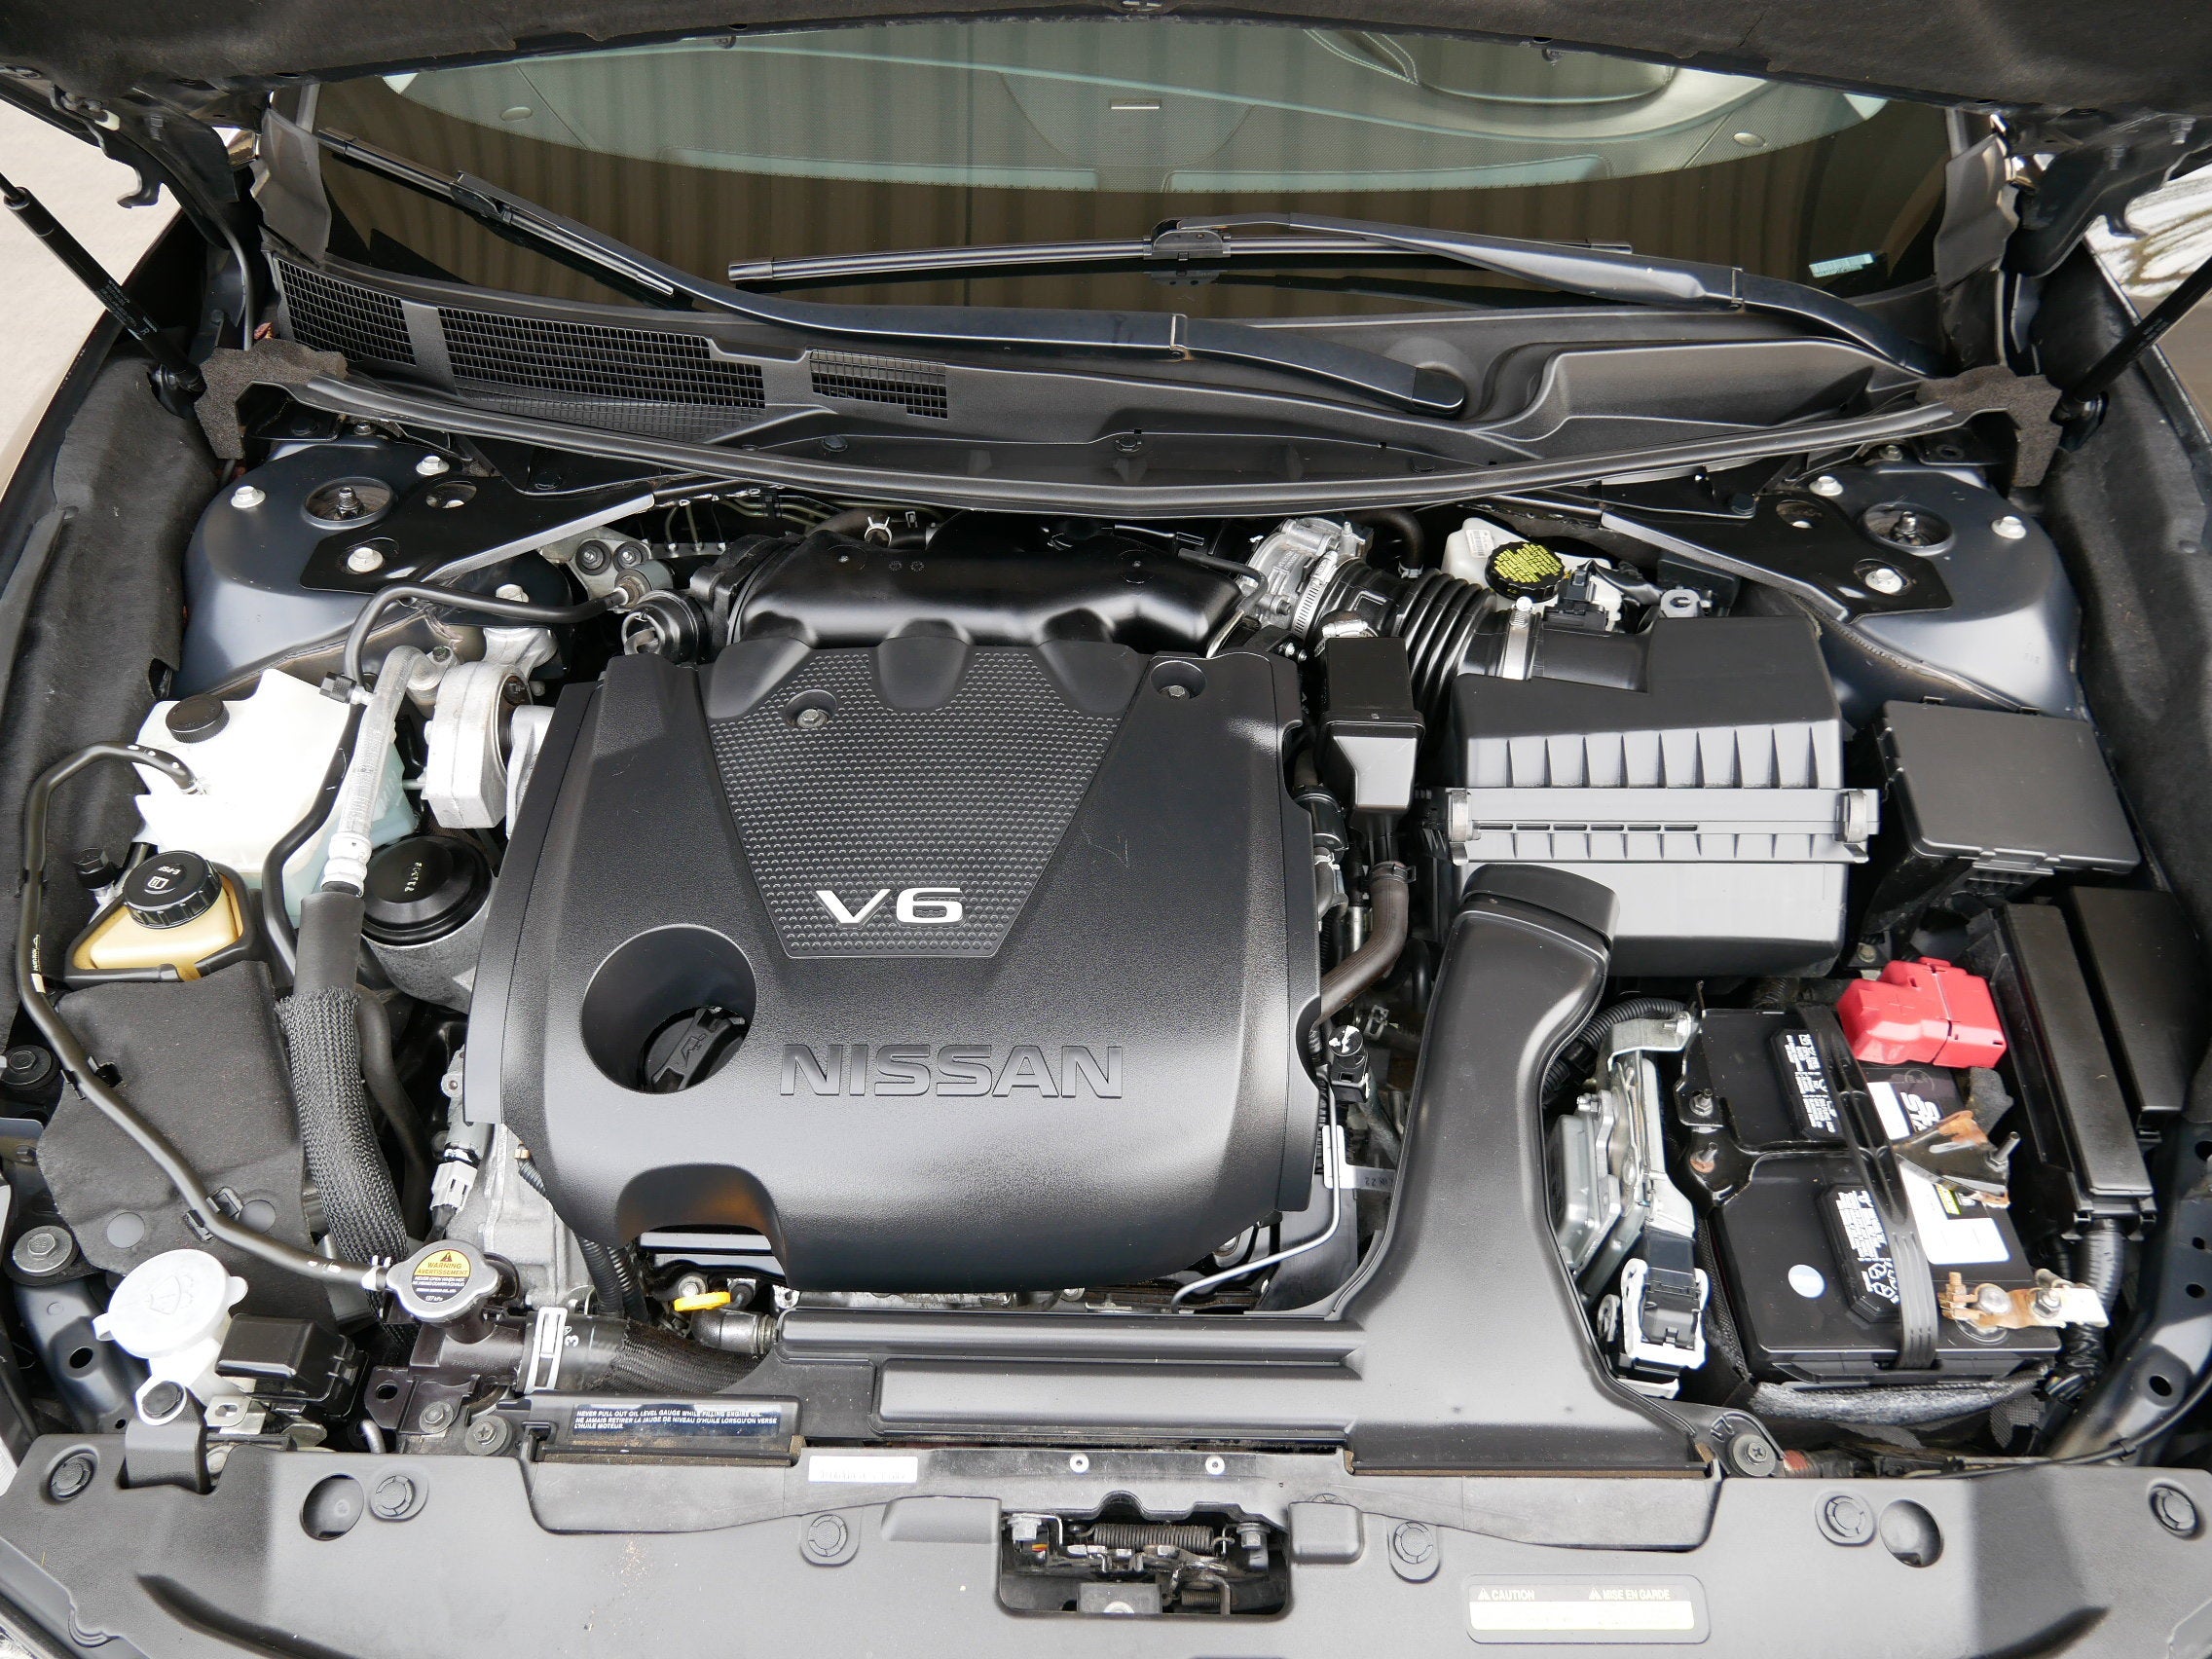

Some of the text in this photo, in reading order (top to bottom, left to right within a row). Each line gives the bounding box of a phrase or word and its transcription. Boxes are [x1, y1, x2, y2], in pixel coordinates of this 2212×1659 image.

[158, 866, 181, 875] E-PSF
[816, 887, 964, 926] V6
[780, 1044, 1123, 1099] NISSAN
[1491, 1589, 1535, 1601] CAUTION
[1603, 1589, 1671, 1601] MISE EN GARDE
